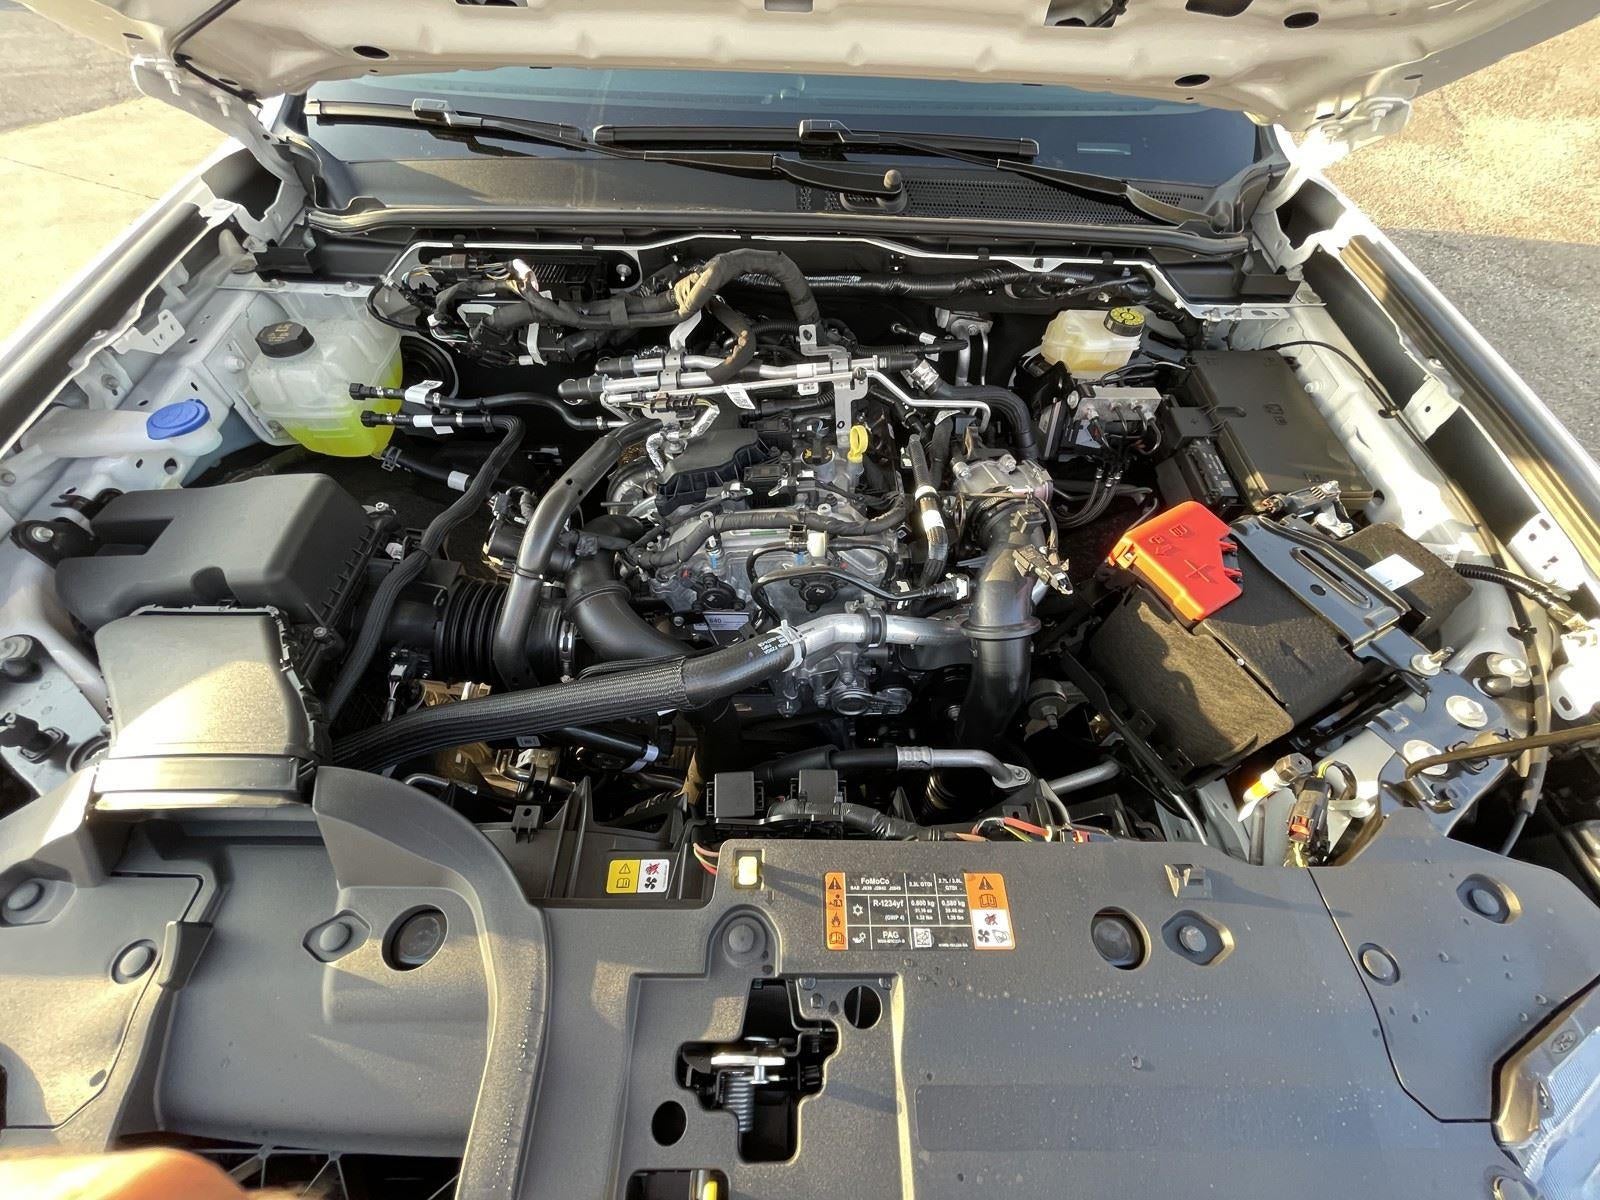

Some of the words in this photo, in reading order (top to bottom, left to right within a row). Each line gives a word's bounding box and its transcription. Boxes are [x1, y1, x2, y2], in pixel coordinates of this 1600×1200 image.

[860, 878, 890, 886] FoMoCo
[873, 900, 904, 908] R-1234yf
[882, 931, 899, 939] PAG
